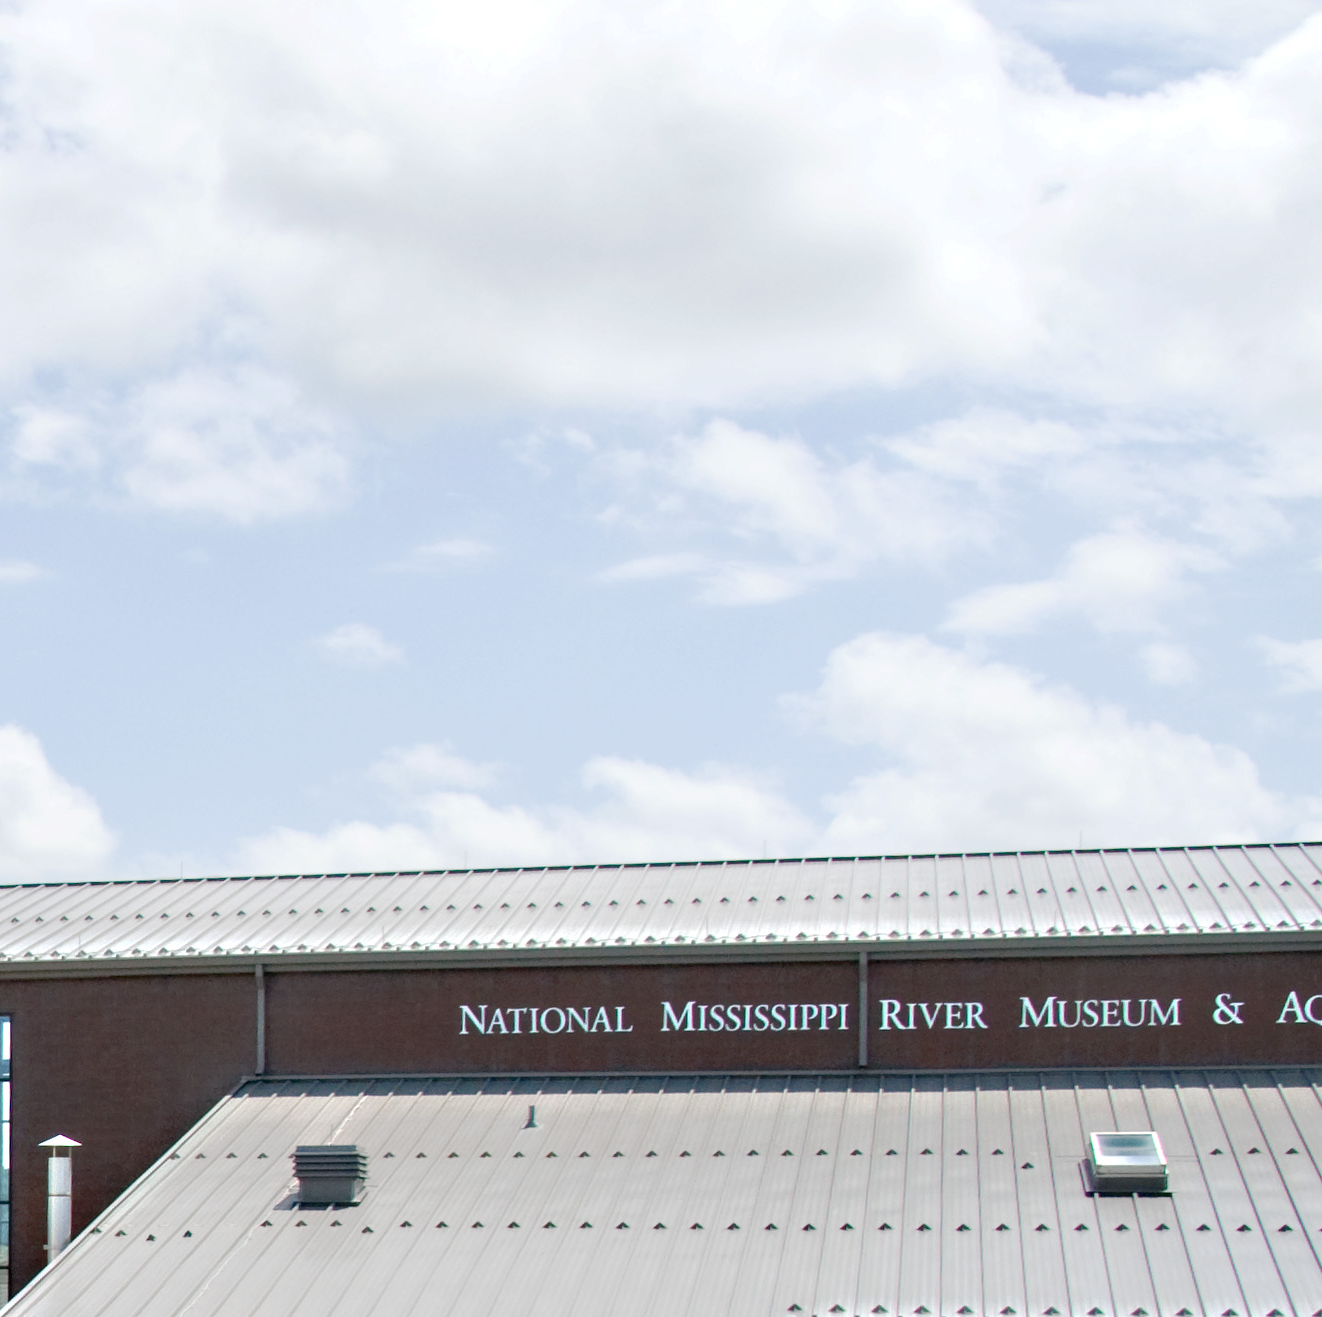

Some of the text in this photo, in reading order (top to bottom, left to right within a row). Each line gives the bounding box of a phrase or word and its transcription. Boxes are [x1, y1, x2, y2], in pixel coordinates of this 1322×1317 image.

[458, 1004, 634, 1035] NATIONAL
[660, 1000, 850, 1032] MISSISSIPPI
[878, 998, 989, 1030] RIVER
[1018, 996, 1183, 1028] MUSEUM
[1212, 993, 1245, 1025] &
